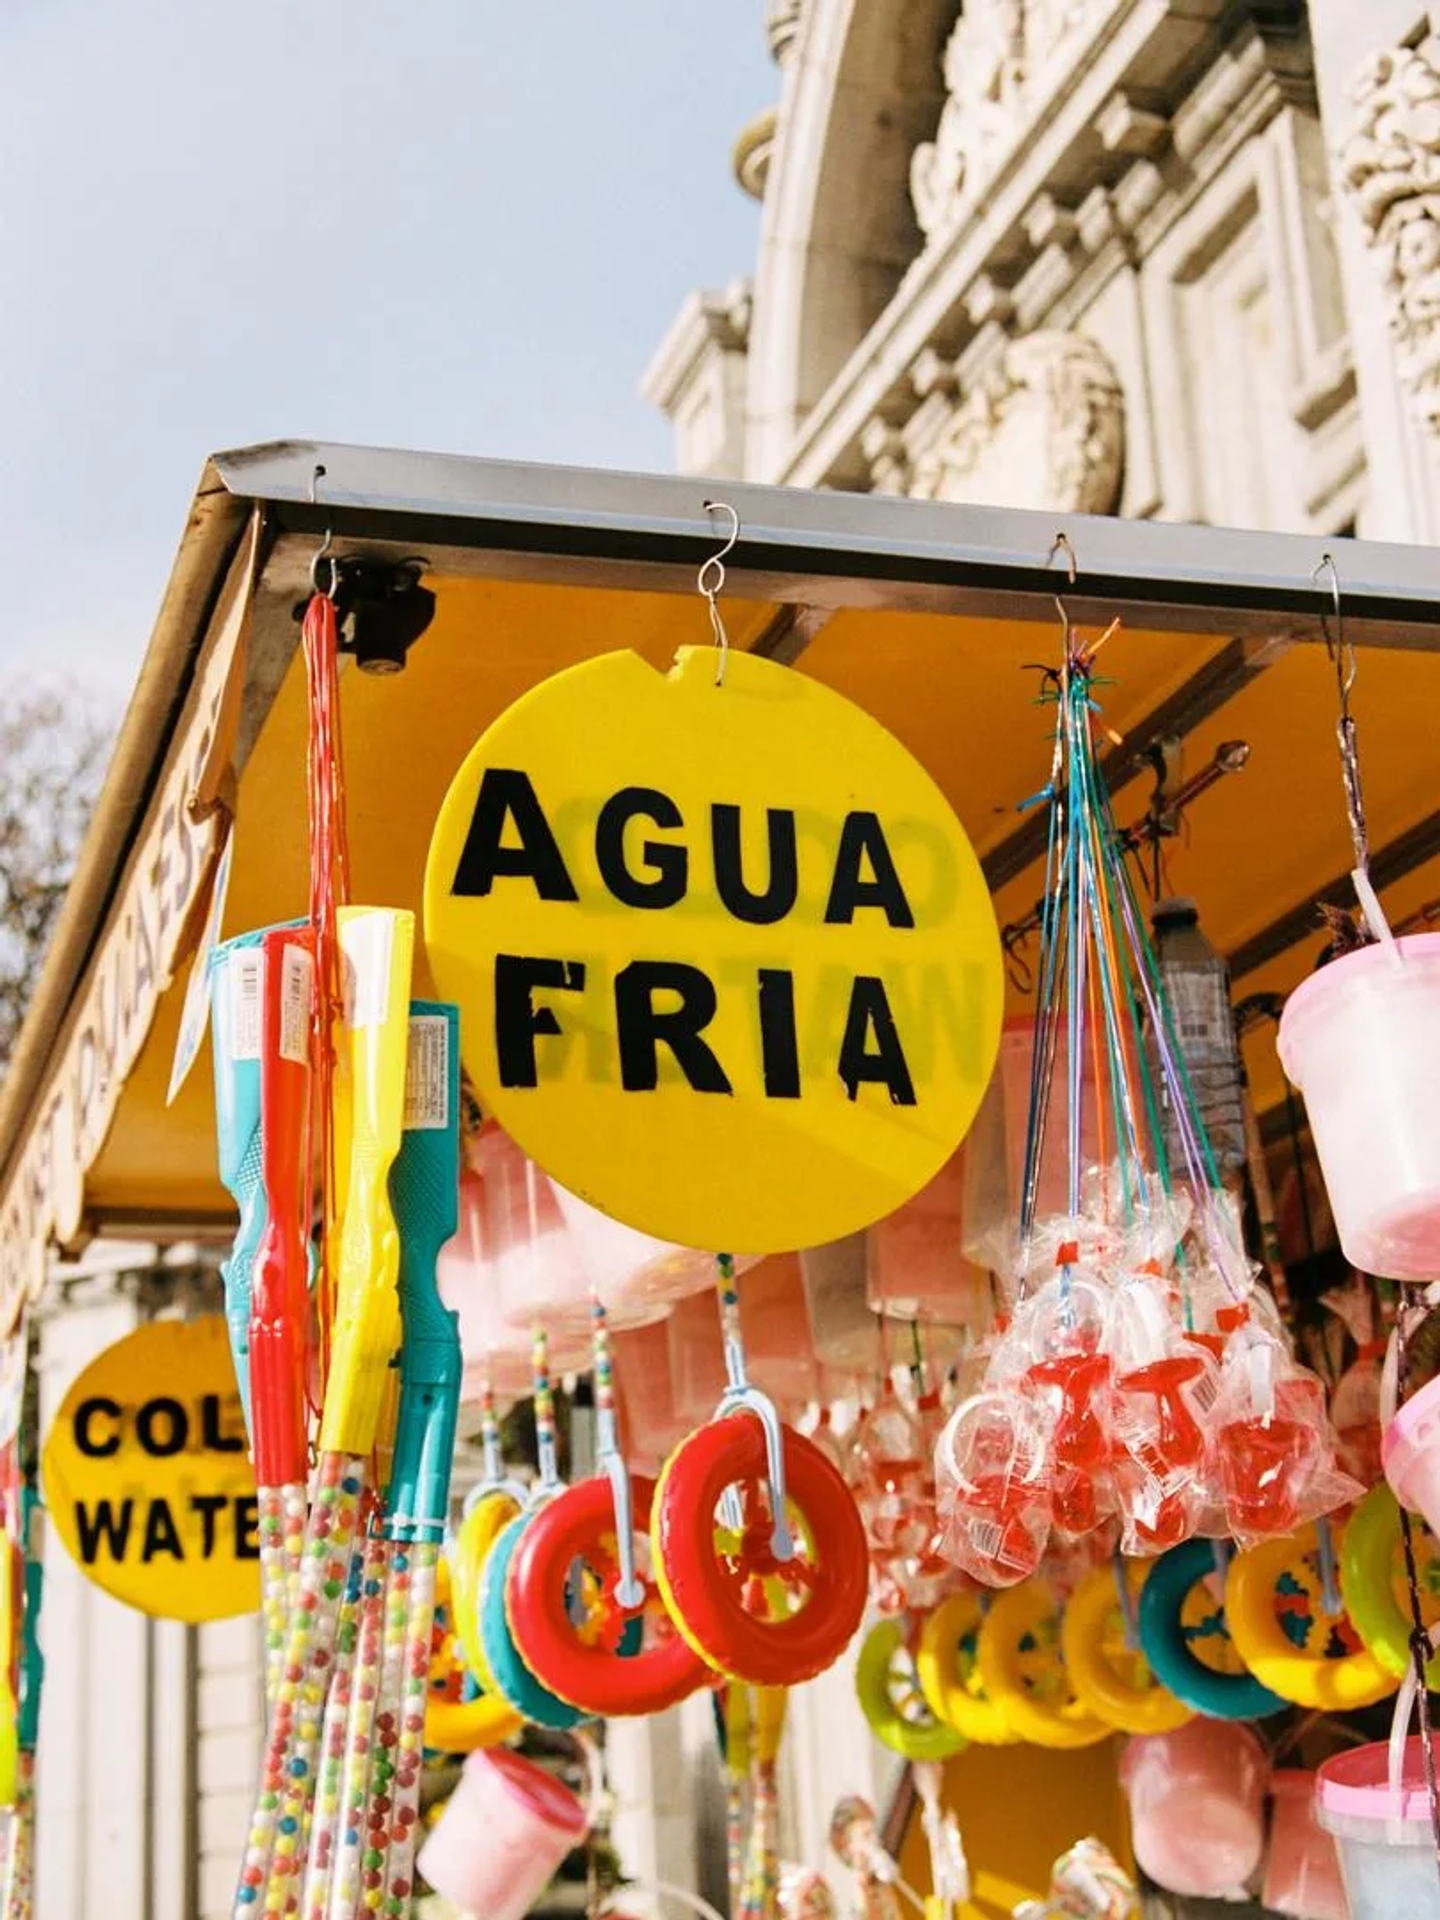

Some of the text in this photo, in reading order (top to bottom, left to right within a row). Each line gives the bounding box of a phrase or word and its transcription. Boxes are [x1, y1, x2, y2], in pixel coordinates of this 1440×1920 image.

[451, 768, 915, 929] AGUA
[494, 953, 918, 1106] FRIA
[74, 1395, 244, 1458] COL
[74, 1495, 260, 1564] WATE
